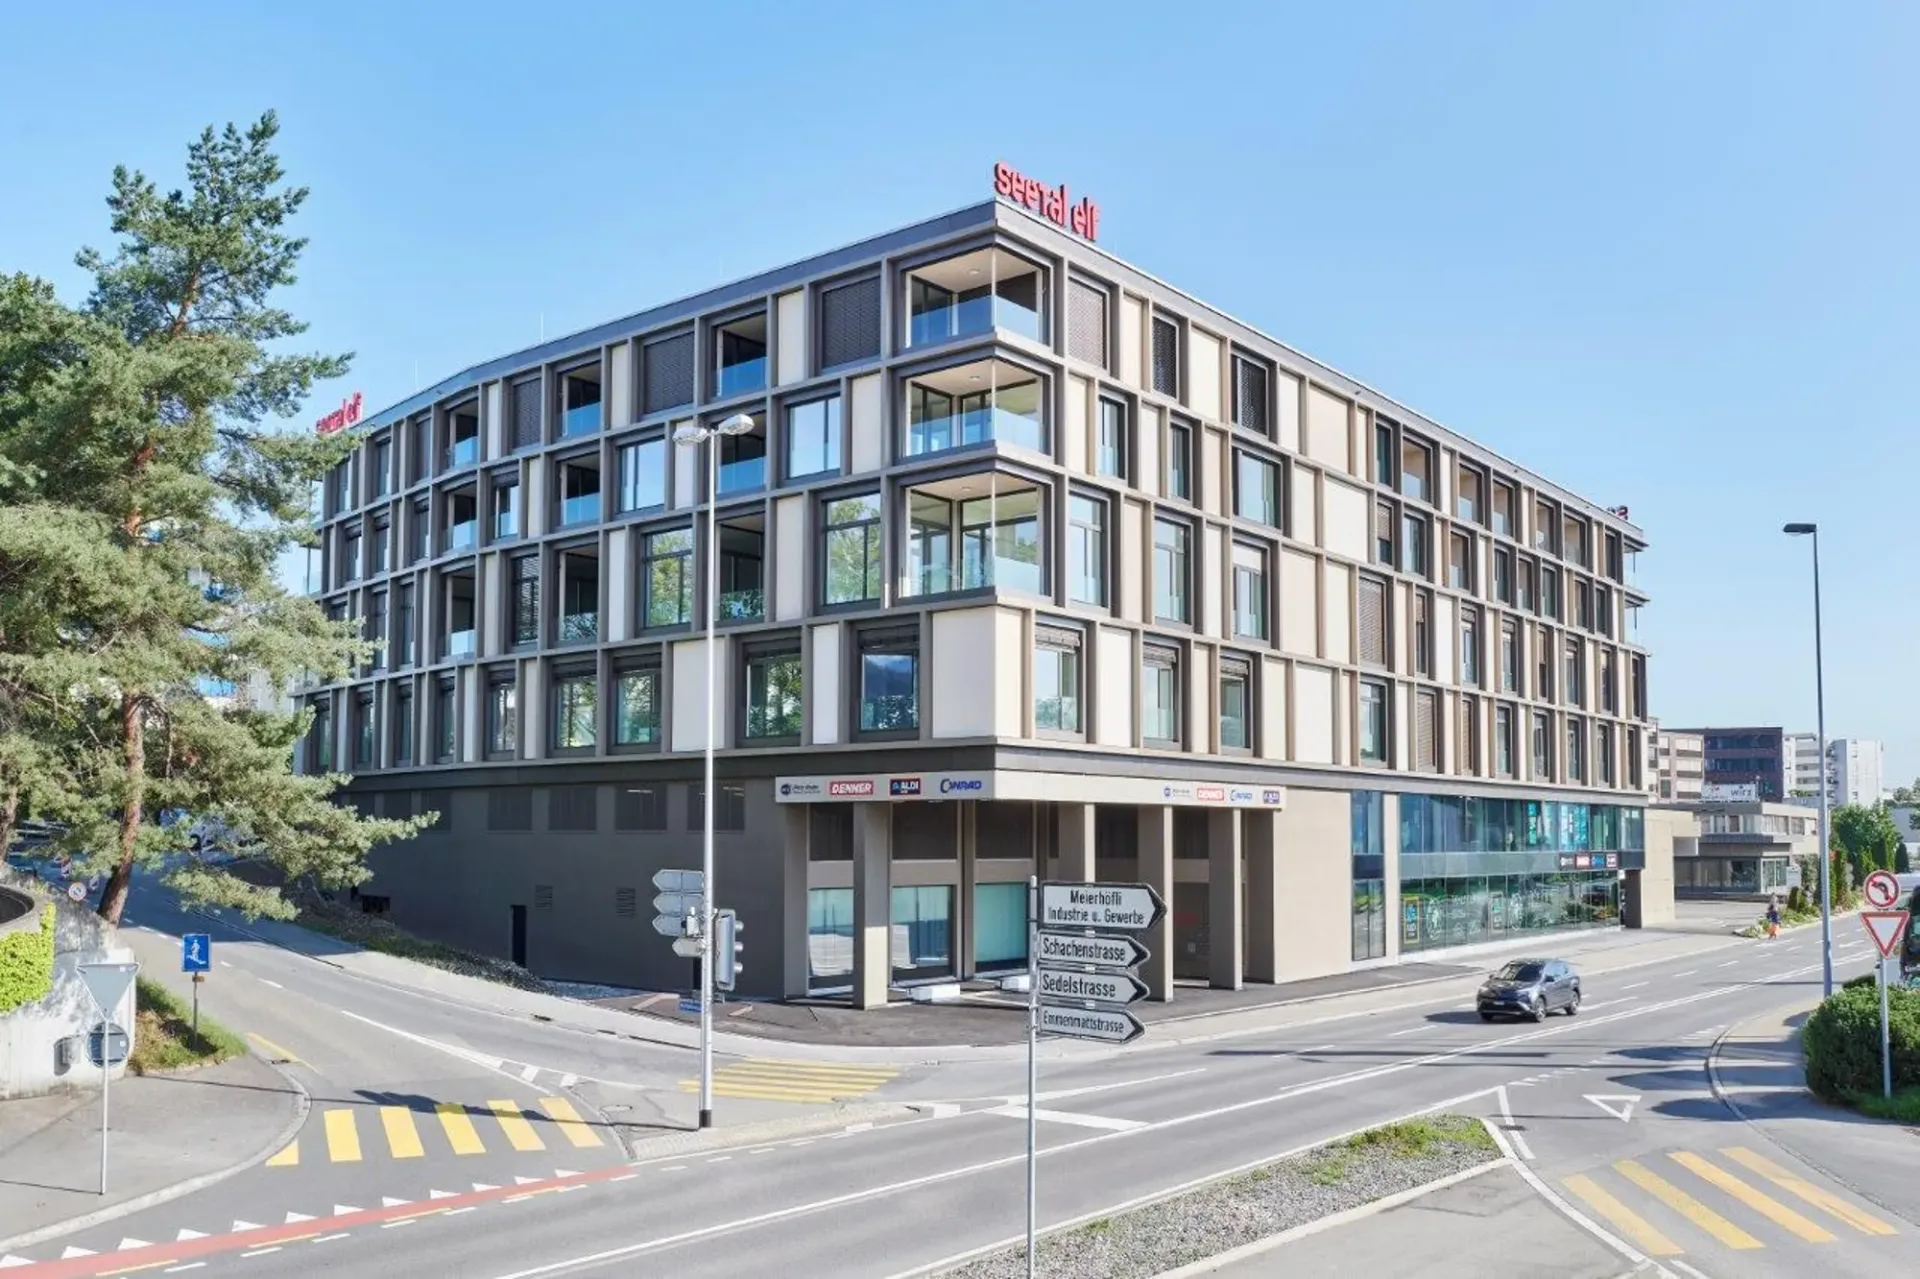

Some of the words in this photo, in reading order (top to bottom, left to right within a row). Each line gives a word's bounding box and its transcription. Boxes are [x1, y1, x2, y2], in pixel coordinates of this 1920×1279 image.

[994, 163, 1066, 227] seetal
[1071, 197, 1099, 242] elf
[831, 783, 871, 794] DENNER
[901, 781, 919, 790] ALDI
[940, 778, 982, 794] CONRAD
[1070, 890, 1122, 905] Meierhöfli
[1048, 907, 1089, 922] Industrie
[1091, 911, 1101, 922] u.
[1104, 909, 1144, 925] Gewerbe
[1043, 937, 1126, 961] Schachenstrasse
[1042, 974, 1116, 997] Sedelstrasse
[1044, 1010, 1125, 1034] Emmenmattstrasse
